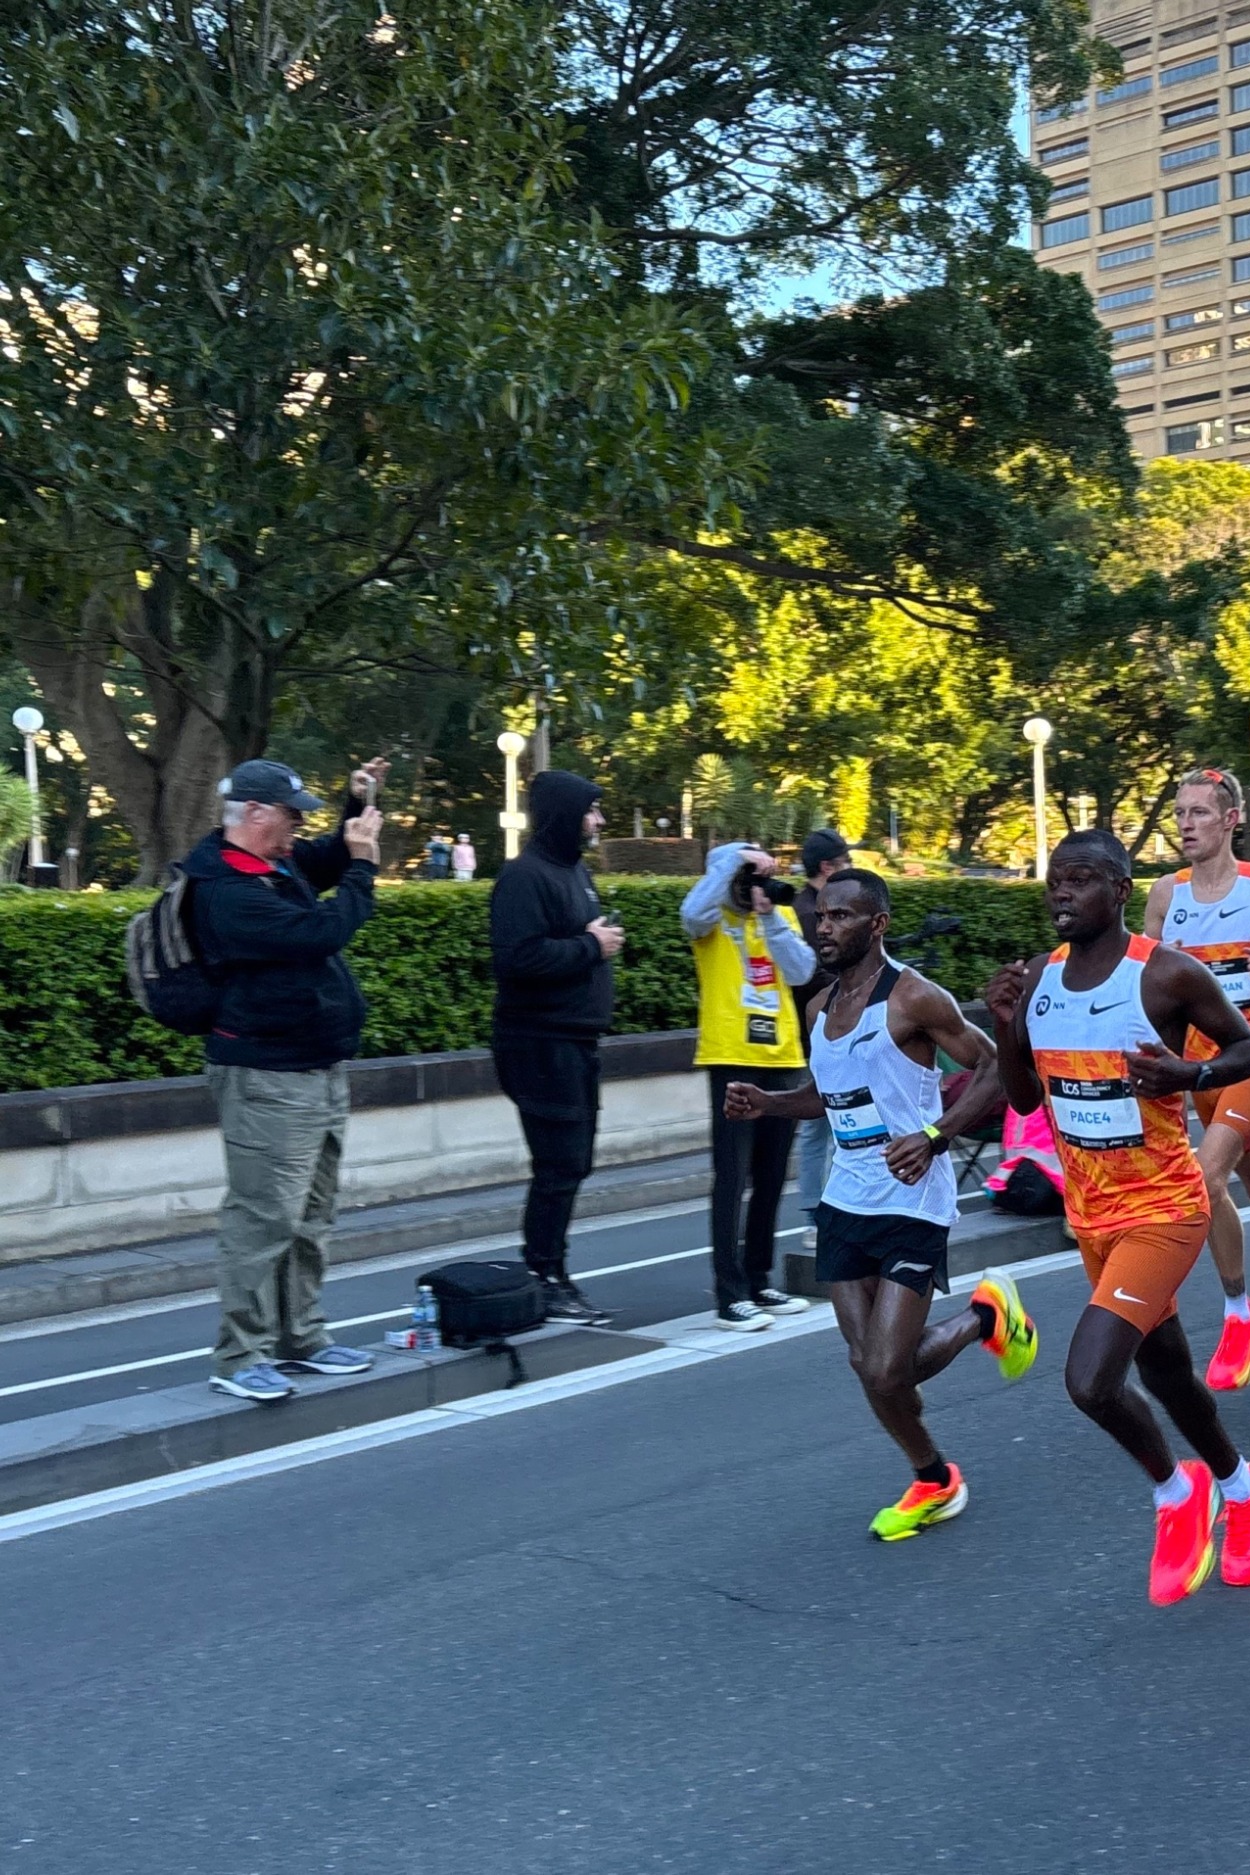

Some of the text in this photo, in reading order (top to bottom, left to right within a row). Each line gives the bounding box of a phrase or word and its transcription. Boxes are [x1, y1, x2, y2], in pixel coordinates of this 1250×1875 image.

[1053, 1002, 1065, 1010] NN
[1061, 1079, 1080, 1096] tcs
[839, 1113, 857, 1129] 45
[1069, 1110, 1111, 1124] PACE4
